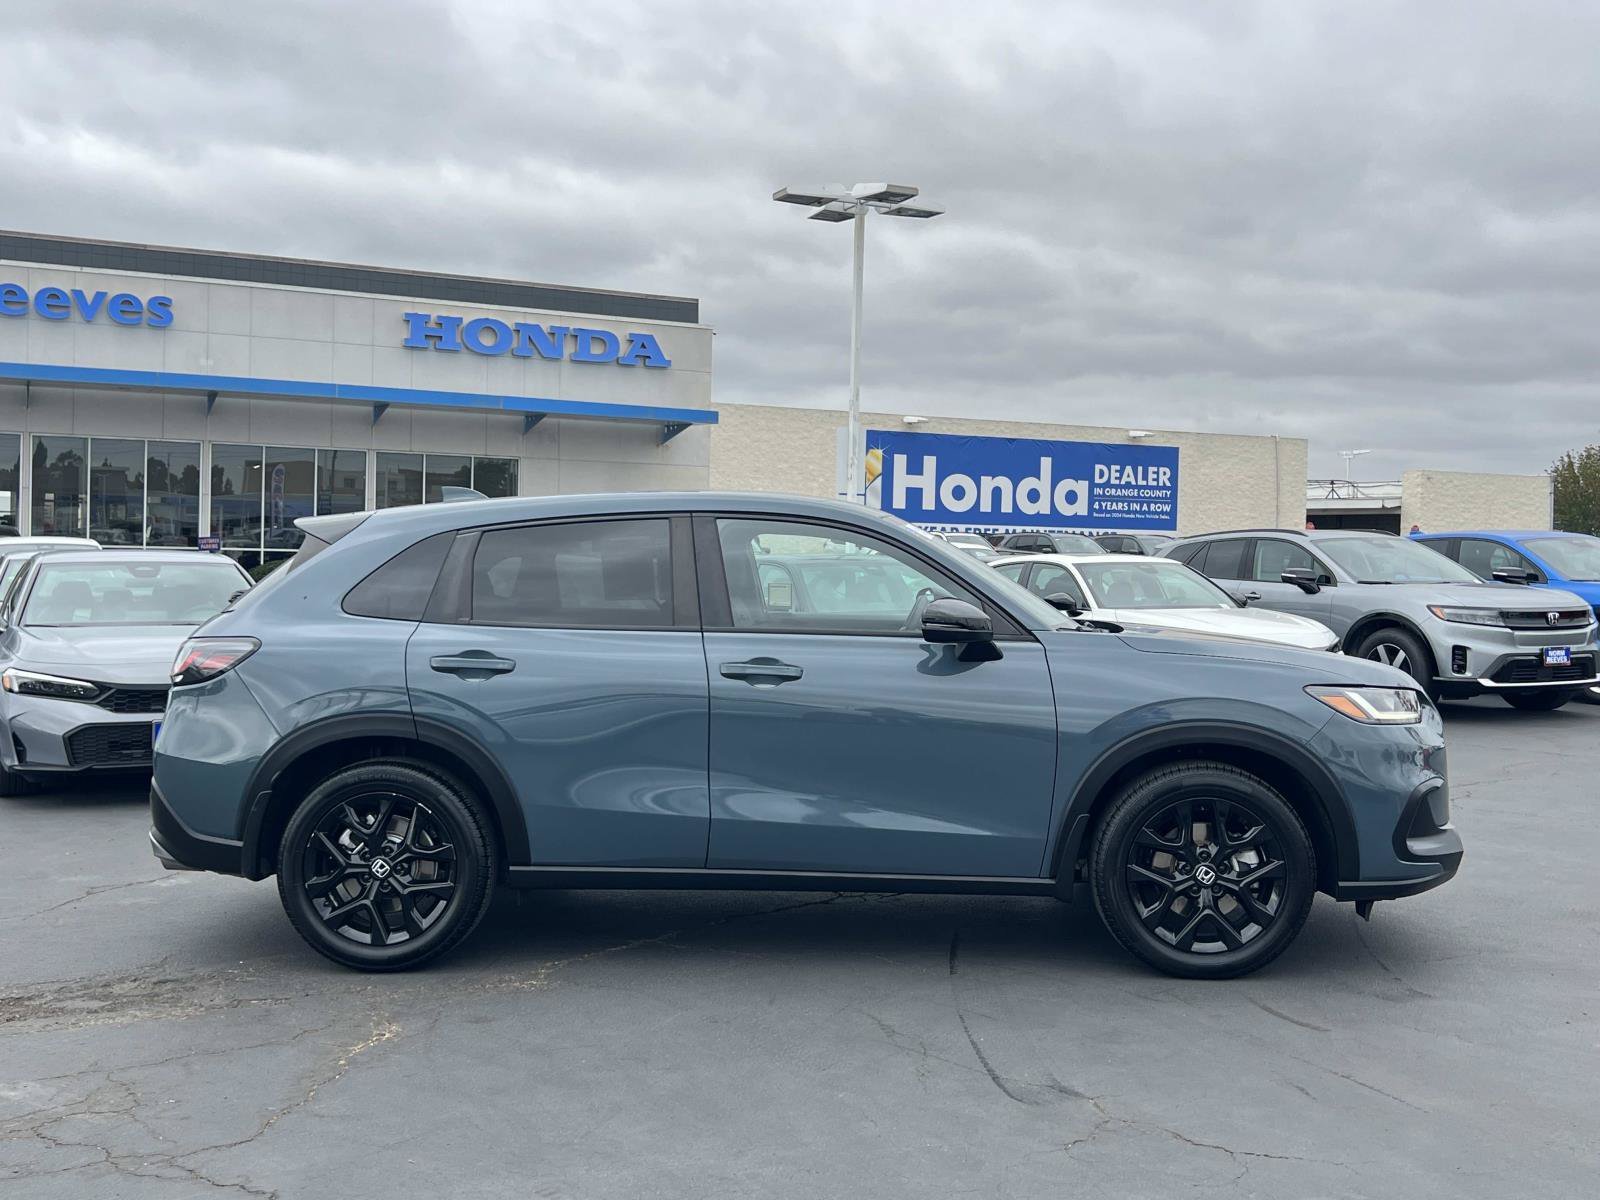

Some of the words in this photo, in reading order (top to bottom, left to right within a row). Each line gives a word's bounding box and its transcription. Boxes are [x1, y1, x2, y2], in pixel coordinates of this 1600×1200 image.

[0, 283, 174, 328] eeves
[403, 312, 672, 368] HONDA
[892, 454, 1089, 517] Honda
[1094, 464, 1171, 486] DEALER
[1093, 501, 1099, 510] 4
[1101, 501, 1128, 511] YEARS
[1130, 502, 1140, 511] IN
[1142, 503, 1149, 512] A
[1150, 503, 1172, 512] ROW
[1094, 487, 1103, 496] IN
[1104, 488, 1138, 497] ORANGE
[1139, 489, 1172, 498] COUNTY
